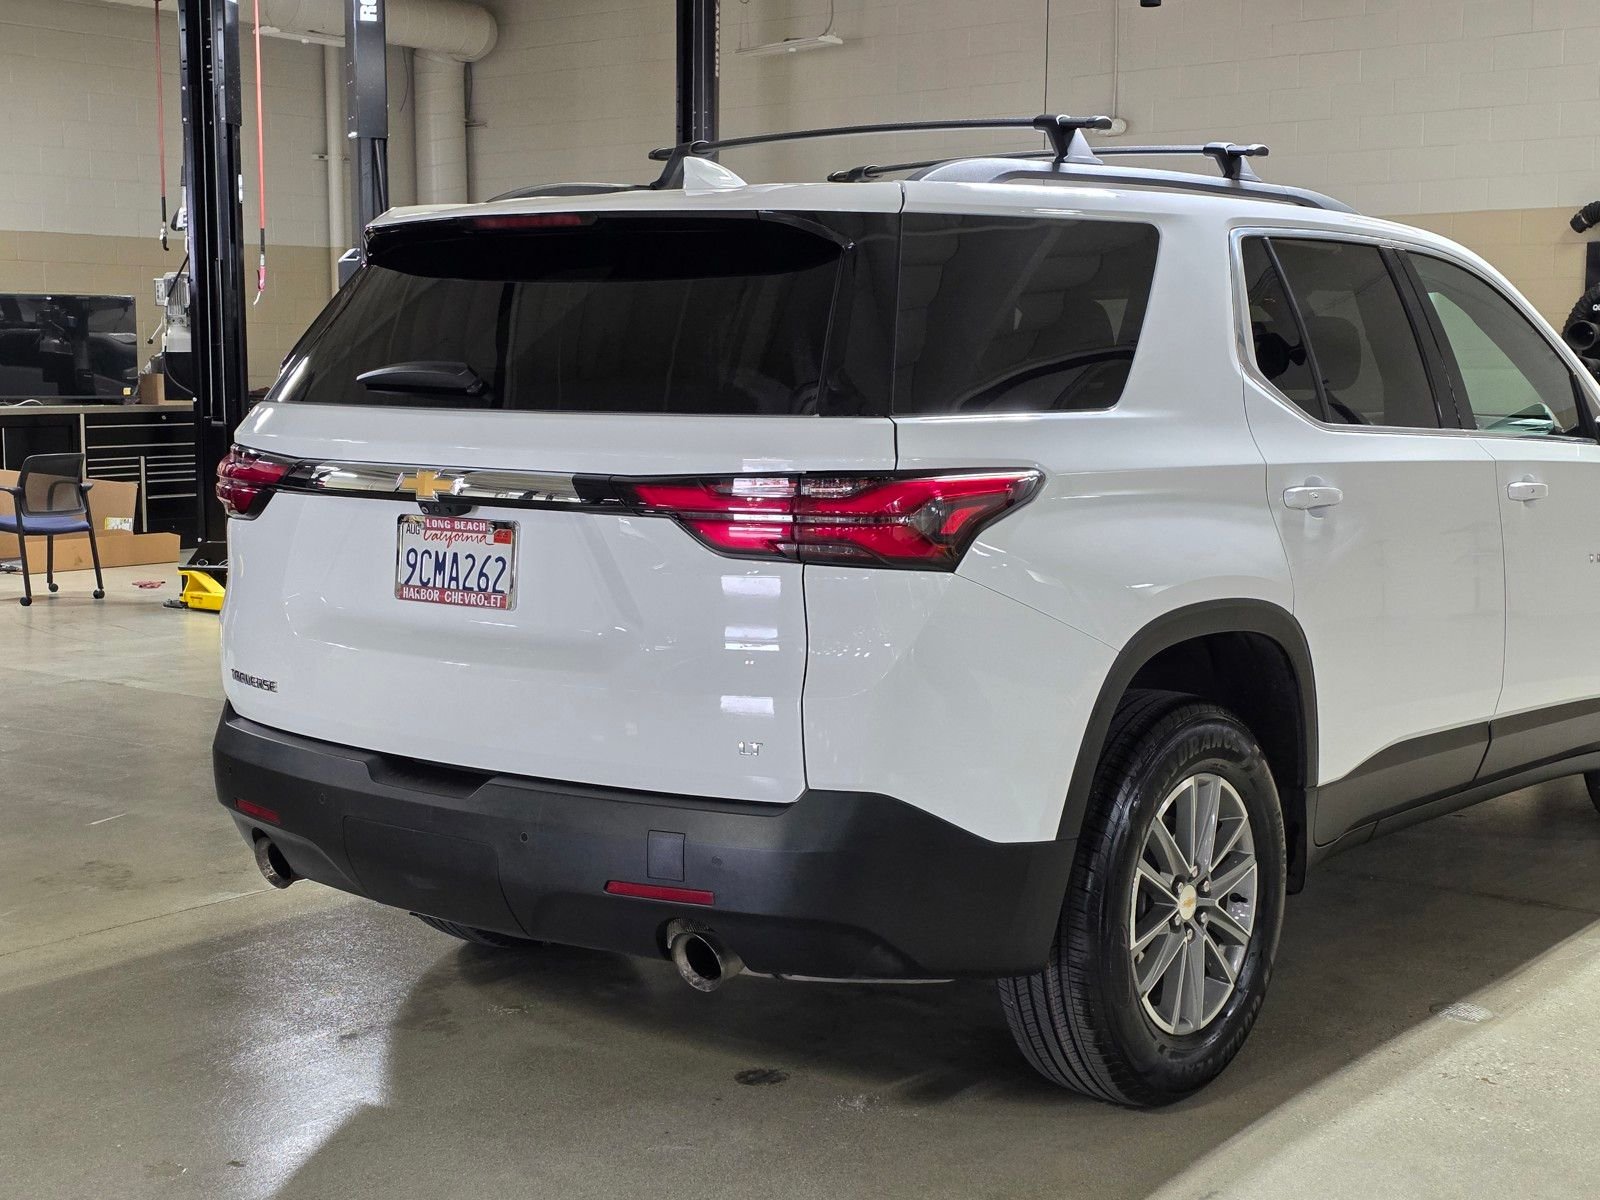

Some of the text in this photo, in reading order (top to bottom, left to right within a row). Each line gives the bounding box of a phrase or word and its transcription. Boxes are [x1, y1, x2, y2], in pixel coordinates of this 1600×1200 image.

[406, 523, 420, 535] AUG
[426, 518, 486, 532] LONG BEACH
[424, 530, 494, 549] California
[404, 547, 507, 594] 9CMA262
[403, 587, 503, 608] HARBOR CHEVROLET
[738, 741, 763, 756] LT
